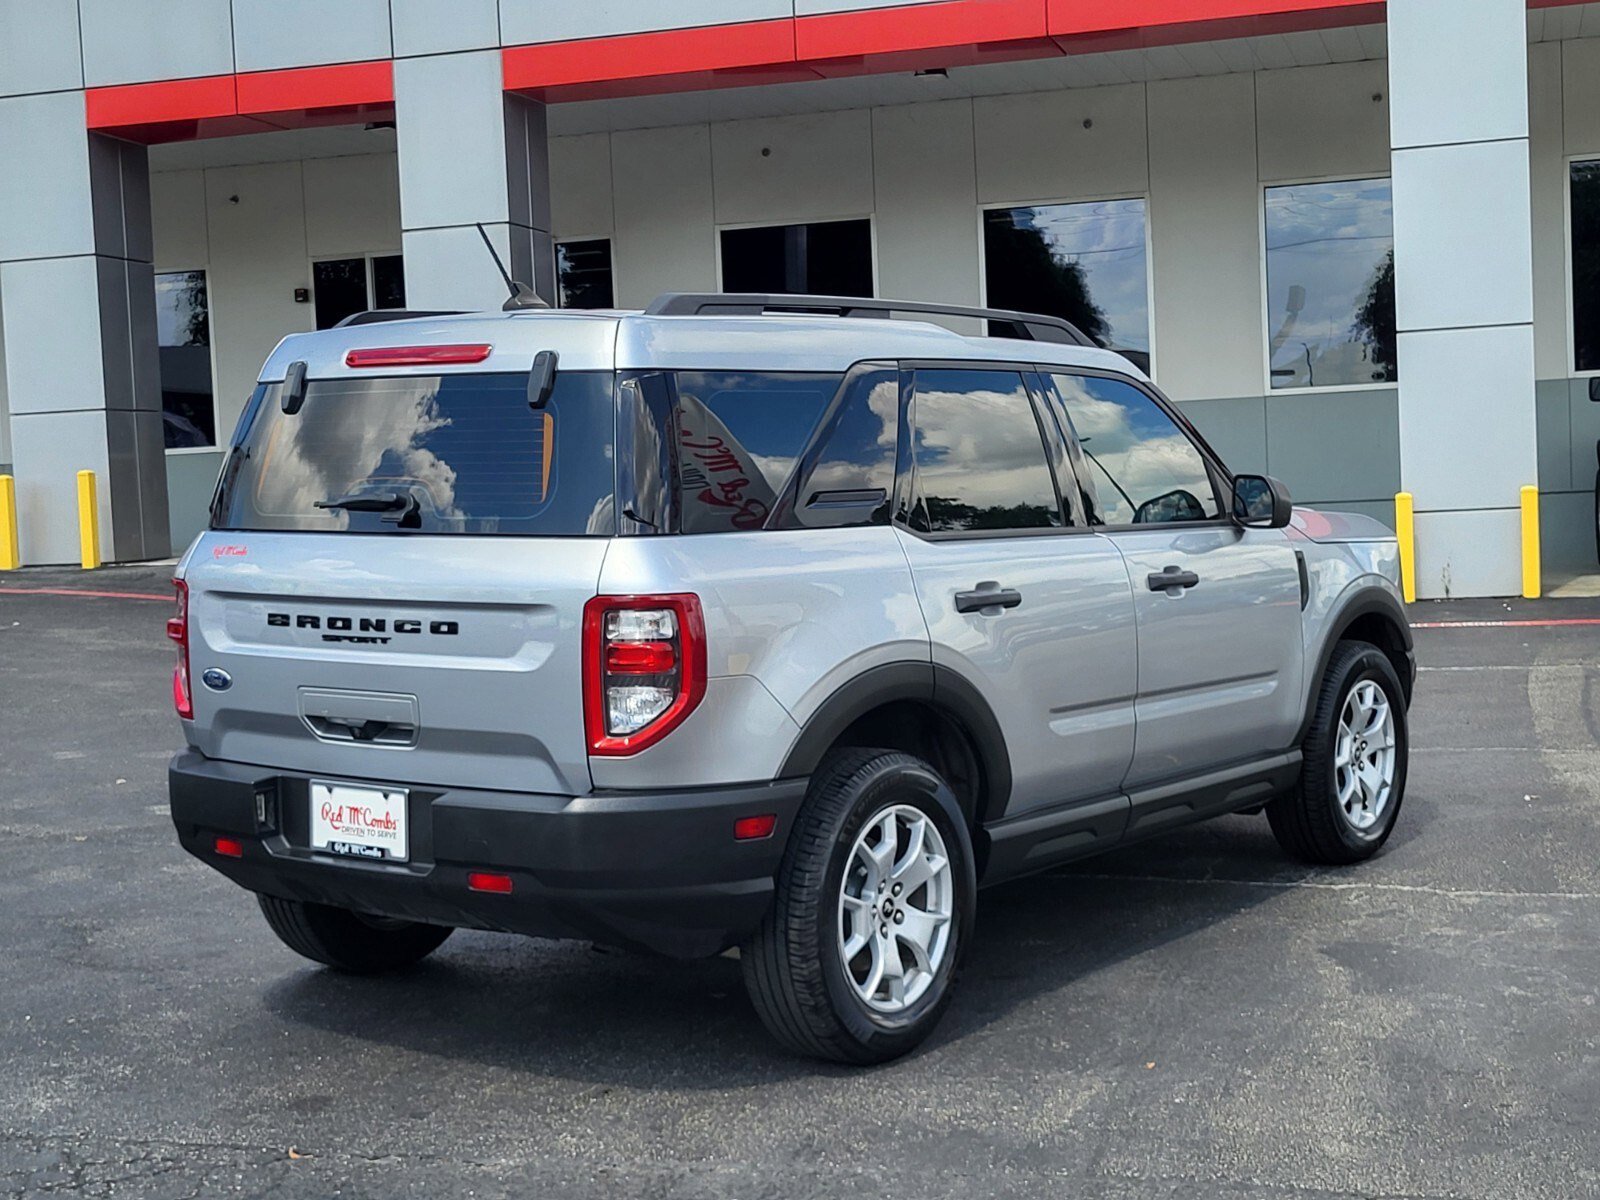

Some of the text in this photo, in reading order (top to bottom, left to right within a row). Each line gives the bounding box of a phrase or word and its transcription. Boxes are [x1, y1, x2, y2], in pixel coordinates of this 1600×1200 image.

[267, 613, 459, 635] BRONCO
[321, 634, 392, 645] SPORT
[321, 801, 397, 831] Red McCombs
[341, 826, 365, 836] DRIVEN
[377, 831, 397, 840] SERVE
